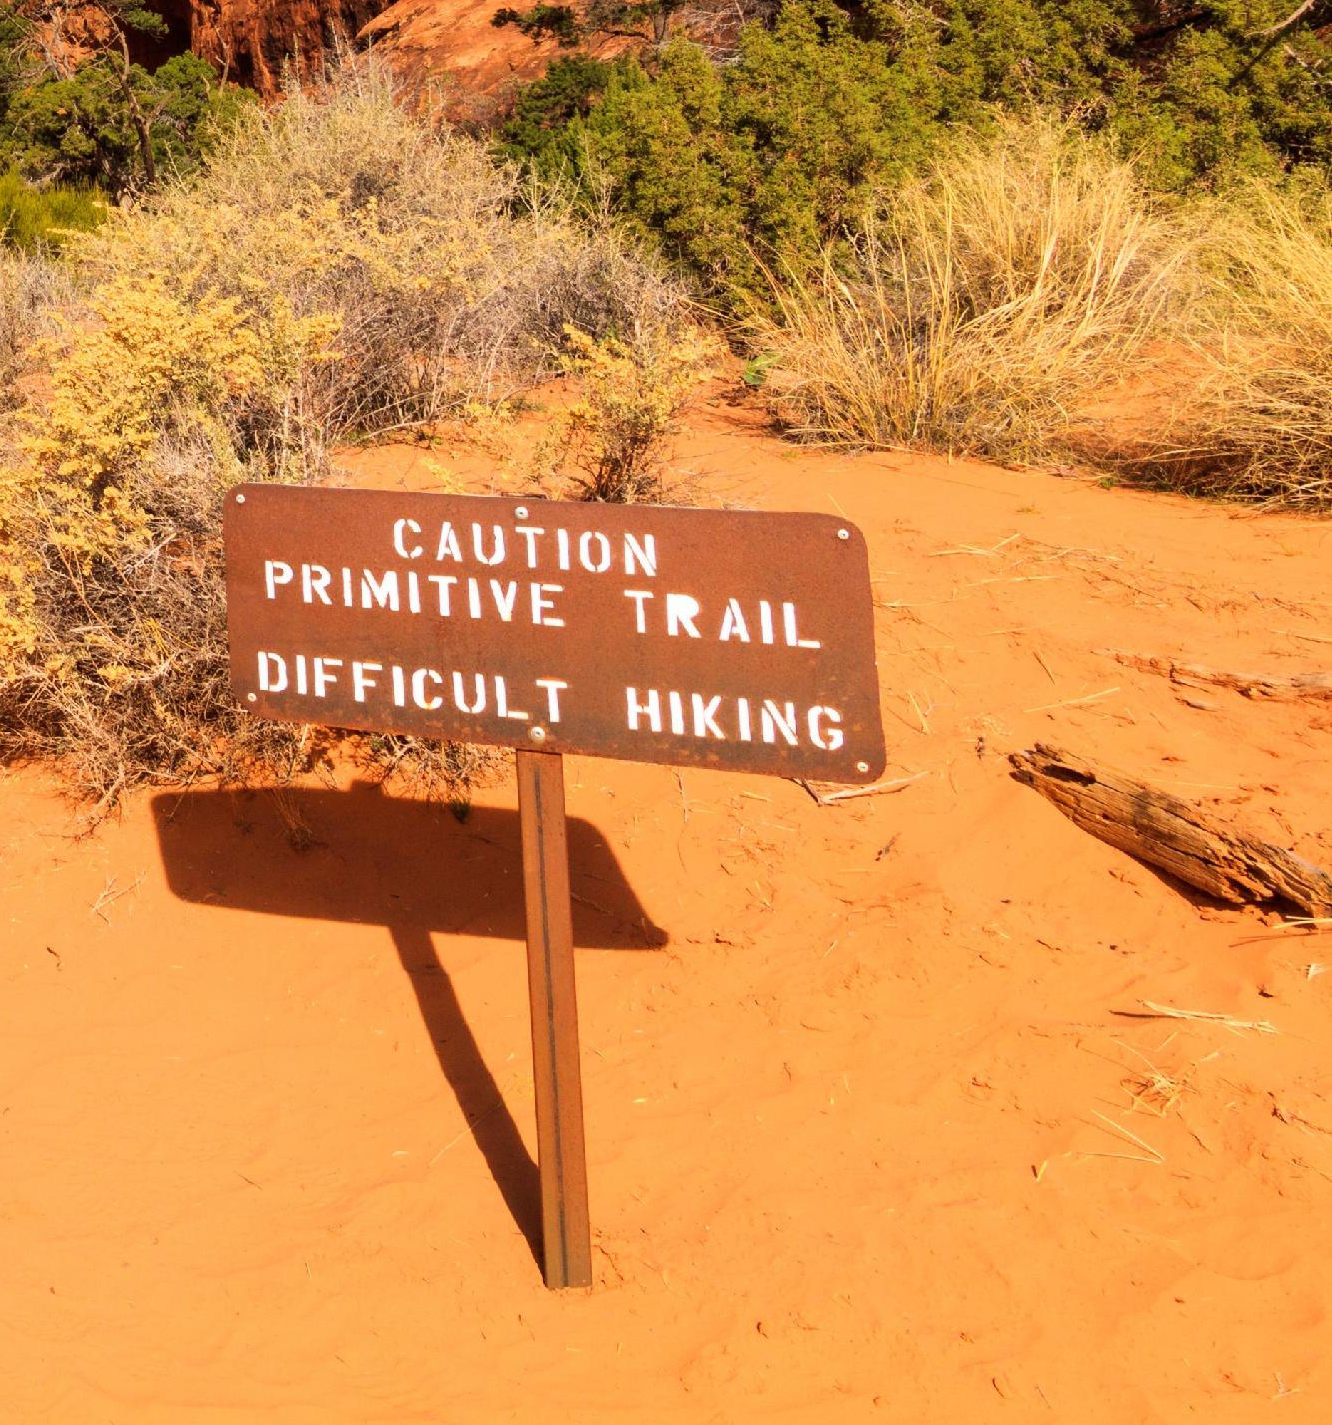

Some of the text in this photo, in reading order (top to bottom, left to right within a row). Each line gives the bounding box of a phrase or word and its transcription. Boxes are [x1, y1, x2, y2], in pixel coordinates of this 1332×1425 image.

[392, 517, 659, 577] CAUTION
[263, 559, 824, 650] PRIMITIVE TRAIL
[256, 649, 846, 752] DIFFICULT HIKING
